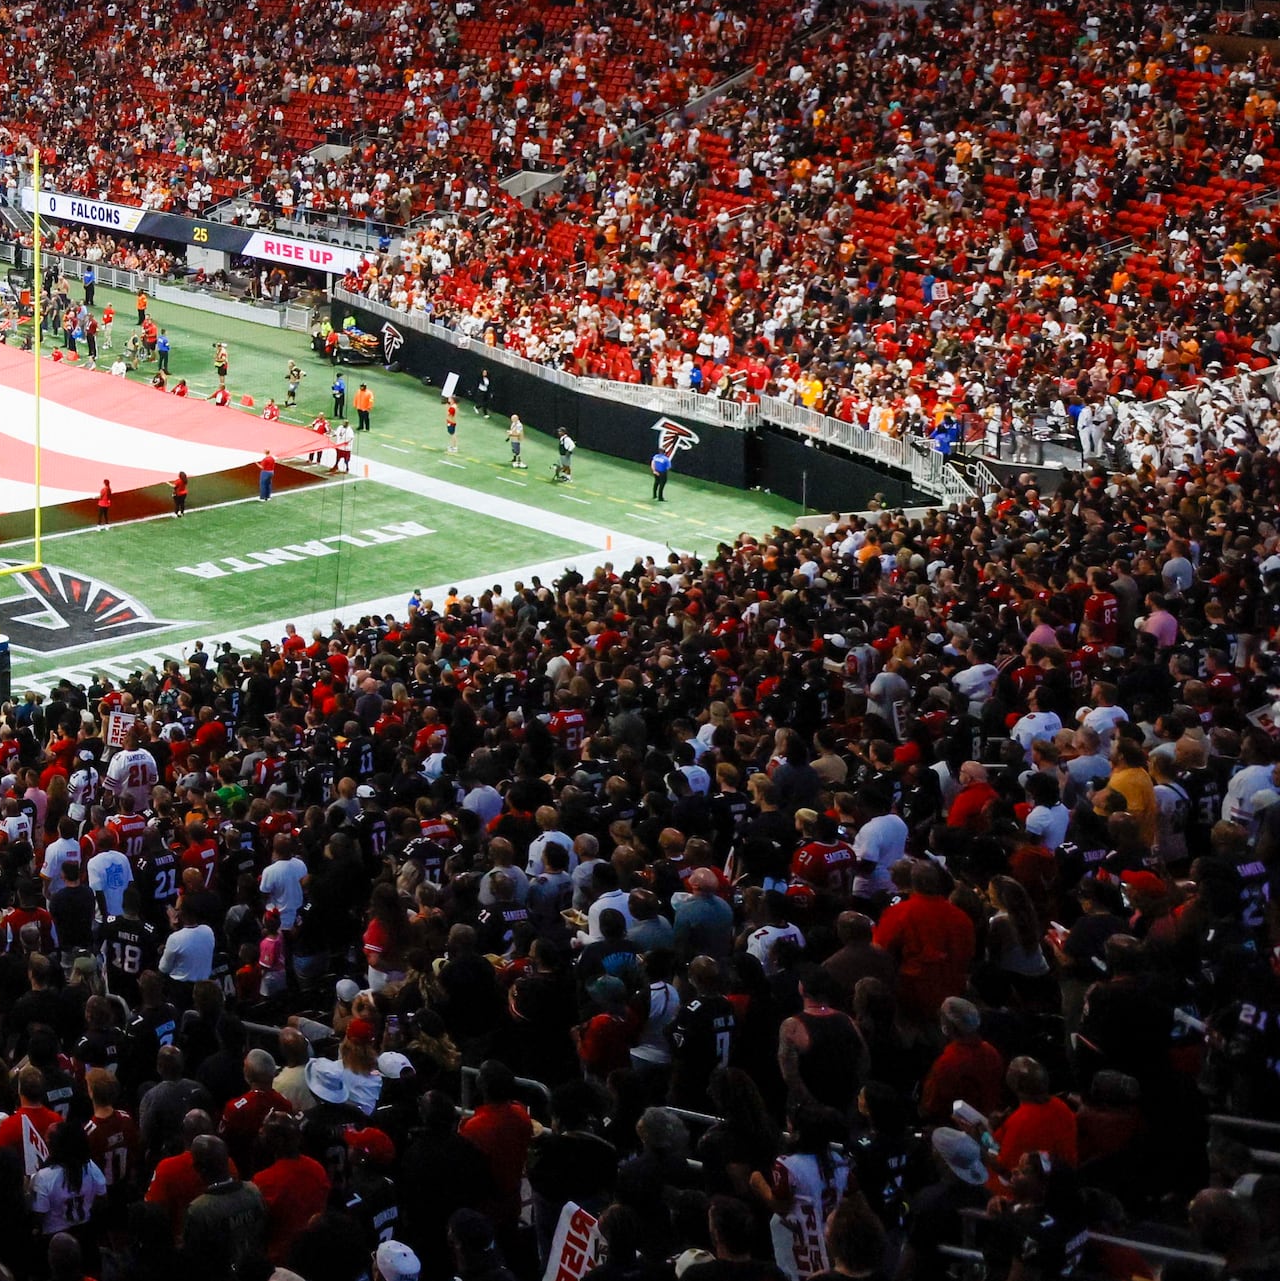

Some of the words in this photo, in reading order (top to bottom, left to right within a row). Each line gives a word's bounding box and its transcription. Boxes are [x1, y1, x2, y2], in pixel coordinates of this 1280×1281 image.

[49, 197, 56, 212] 0
[71, 201, 120, 225] FALCONS
[193, 227, 208, 243] 25
[264, 240, 304, 261] RISE
[309, 249, 334, 265] UP
[175, 520, 438, 580] ATLANTA
[566, 725, 585, 751] 21
[127, 752, 146, 763] SANDERS
[359, 751, 374, 774] 11
[128, 763, 150, 788] 21
[126, 837, 142, 856] 10
[798, 850, 813, 865] 21
[823, 848, 851, 866] SANDERS
[154, 869, 178, 899] 21
[204, 862, 214, 888] 7
[477, 909, 491, 924] 21
[502, 908, 528, 923] SANDERS
[112, 941, 142, 974] 18
[686, 999, 702, 1012] 9
[130, 1015, 144, 1026] 7
[77, 1036, 89, 1047] 7
[346, 1192, 362, 1208] 7
